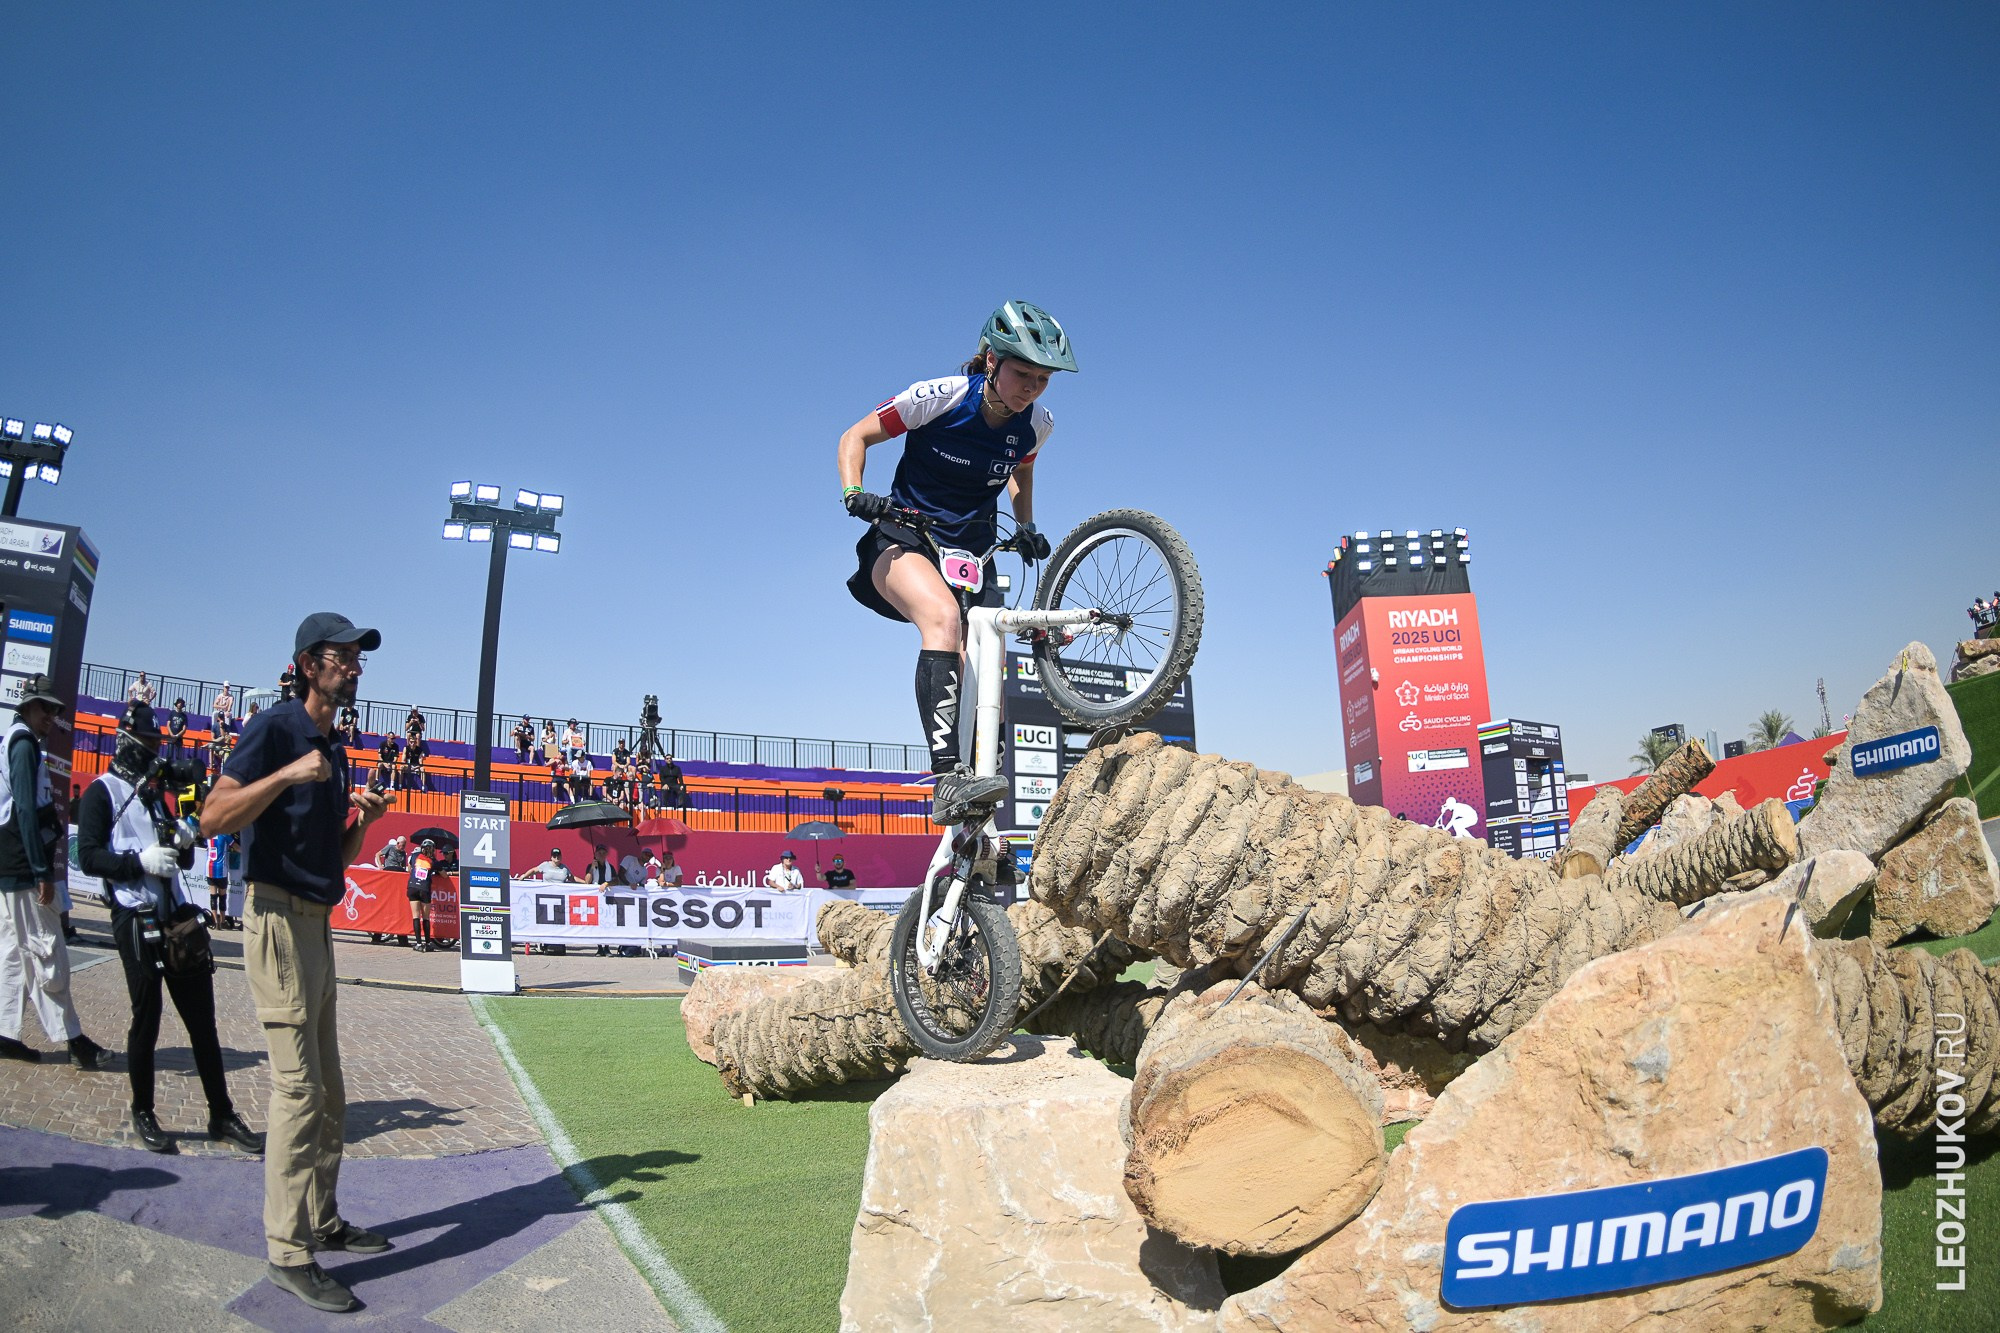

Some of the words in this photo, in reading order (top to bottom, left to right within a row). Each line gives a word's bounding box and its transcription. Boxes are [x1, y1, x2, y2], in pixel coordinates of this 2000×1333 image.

[915, 382, 949, 399] CIC
[958, 563, 969, 578] 6
[1388, 608, 1459, 629] RIYADH
[9, 618, 53, 634] SHIMANO
[1392, 631, 1430, 645] 2025
[1433, 629, 1461, 643] UCI
[1393, 647, 1415, 655] URBAN
[1415, 646, 1441, 654] CYCLING
[1394, 653, 1463, 664] CHAMPIONSHIPS
[1424, 684, 1449, 694] الرياضة
[1451, 682, 1469, 692] وزارة
[6, 688, 24, 699] TISS
[1425, 694, 1446, 702] Ministry
[1453, 692, 1470, 701] Sport
[1423, 717, 1443, 725] SAUDI
[1444, 715, 1471, 723] CYCLING
[1024, 730, 1052, 745] UCI
[1411, 752, 1427, 760] UCI
[1854, 735, 1938, 768] SHIMANO
[1022, 786, 1052, 795] TISSOT
[464, 816, 507, 831] START
[473, 833, 497, 864] 4
[1539, 850, 1554, 859] UCI
[471, 875, 499, 883] SHIMANO
[431, 890, 457, 903] ADH
[439, 904, 457, 913] UCI
[605, 895, 772, 930] TISSOT
[468, 915, 504, 923] #Riyadh2025
[688, 954, 699, 972] UCI
[1456, 1179, 1815, 1279] SHIMANO
